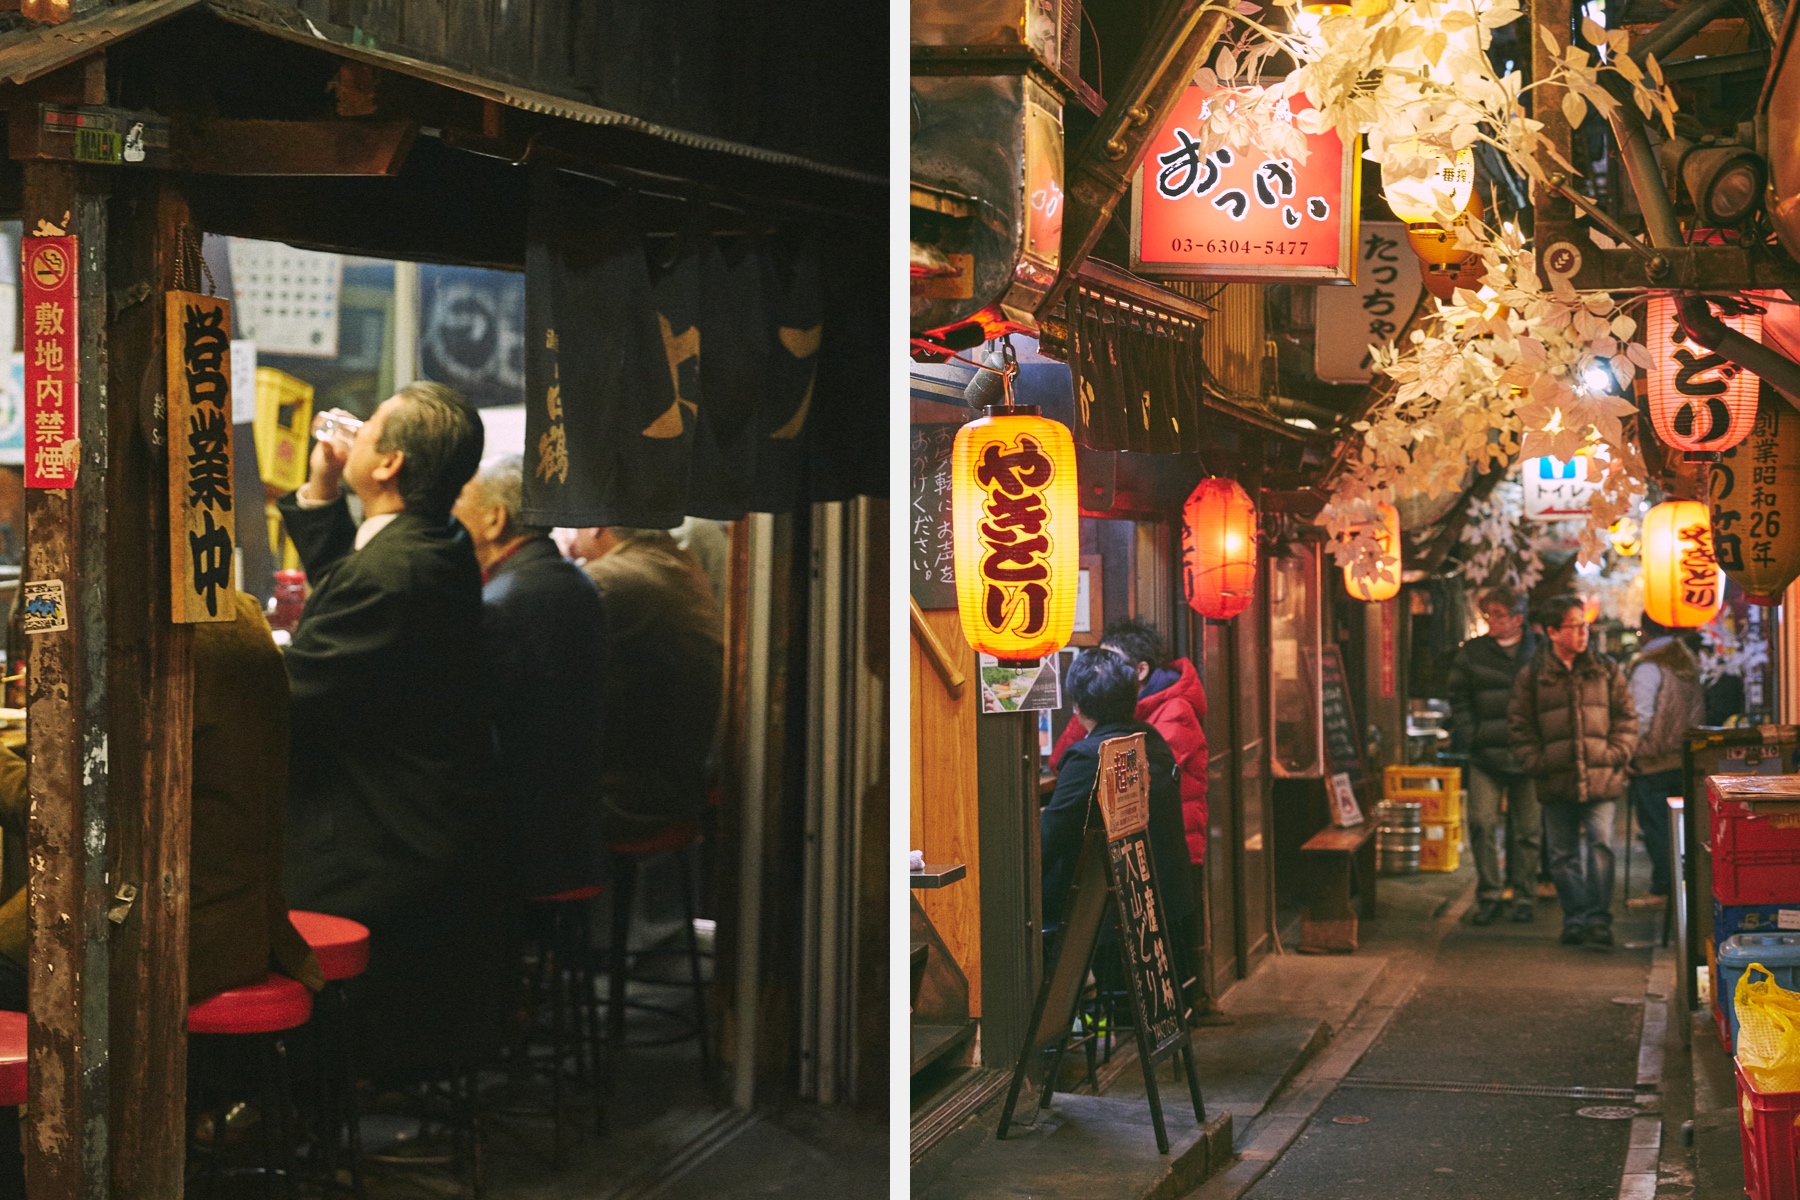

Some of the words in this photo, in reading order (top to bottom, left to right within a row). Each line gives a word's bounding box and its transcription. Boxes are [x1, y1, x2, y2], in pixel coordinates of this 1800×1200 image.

[1172, 237, 1309, 256] 03-6304-5477
[35, 302, 65, 479] 敷地内禁煙
[184, 304, 232, 617] 営業中
[976, 435, 1053, 636] やきとり
